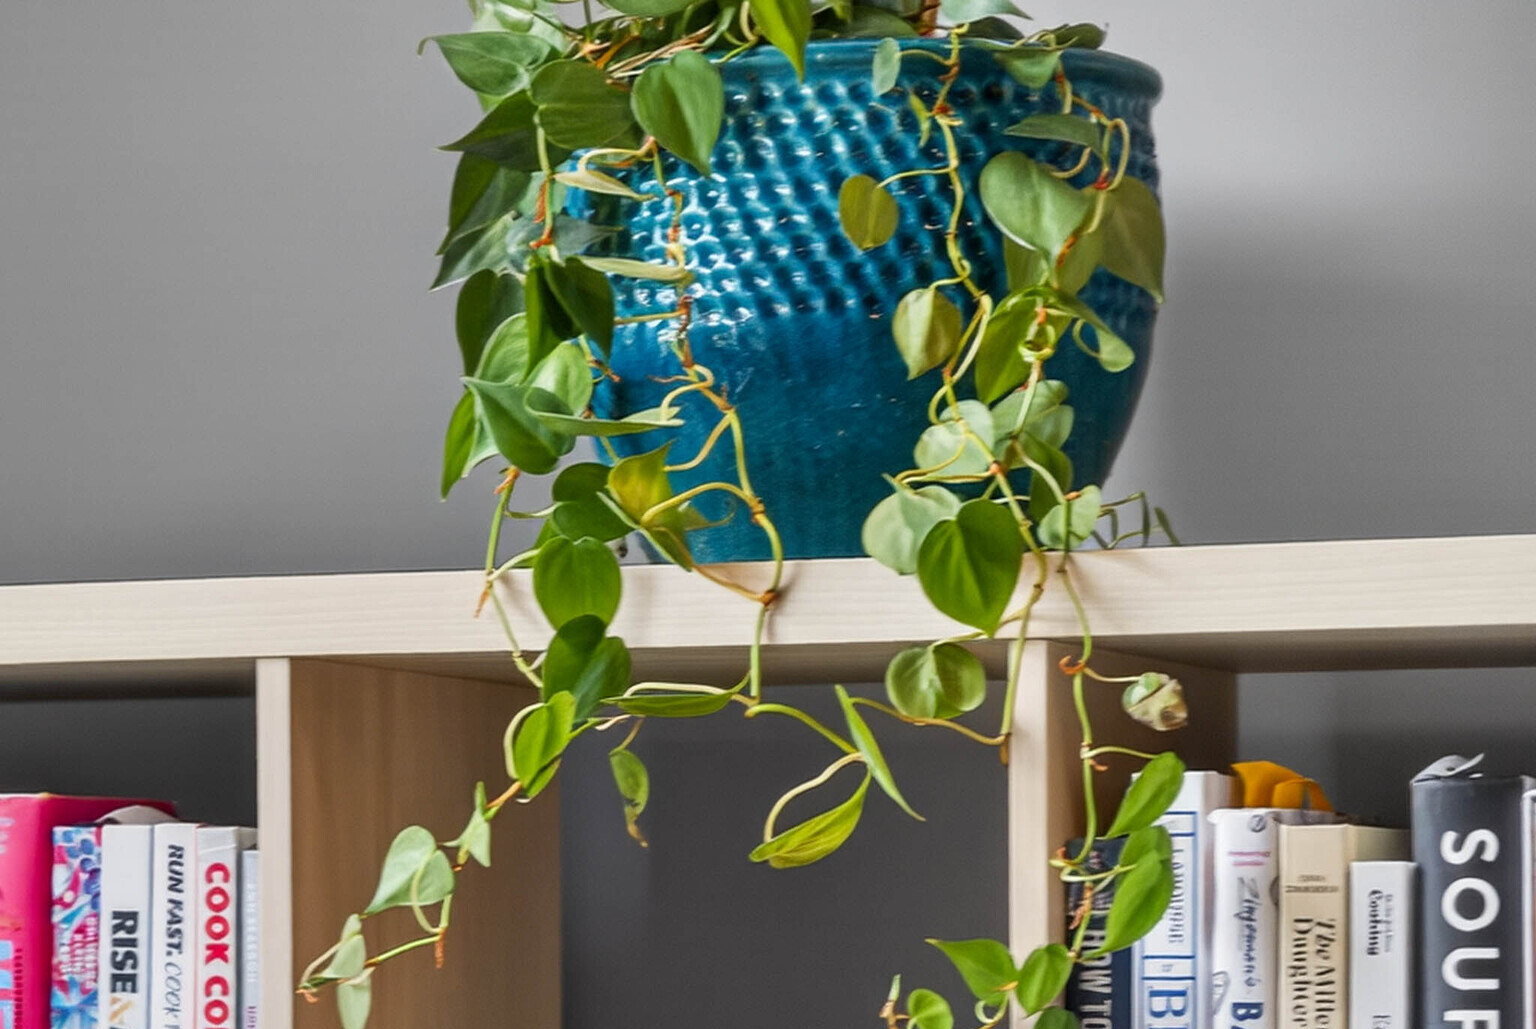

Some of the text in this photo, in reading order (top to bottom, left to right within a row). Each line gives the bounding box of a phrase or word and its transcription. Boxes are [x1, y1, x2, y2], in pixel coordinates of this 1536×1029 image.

[167, 845, 184, 894] RUN
[204, 862, 231, 965] COOK
[1314, 918, 1336, 960] The
[110, 910, 140, 994] RISE
[1290, 917, 1314, 1027] Daughter
[109, 996, 135, 1025] &
[163, 962, 182, 1018] COOK
